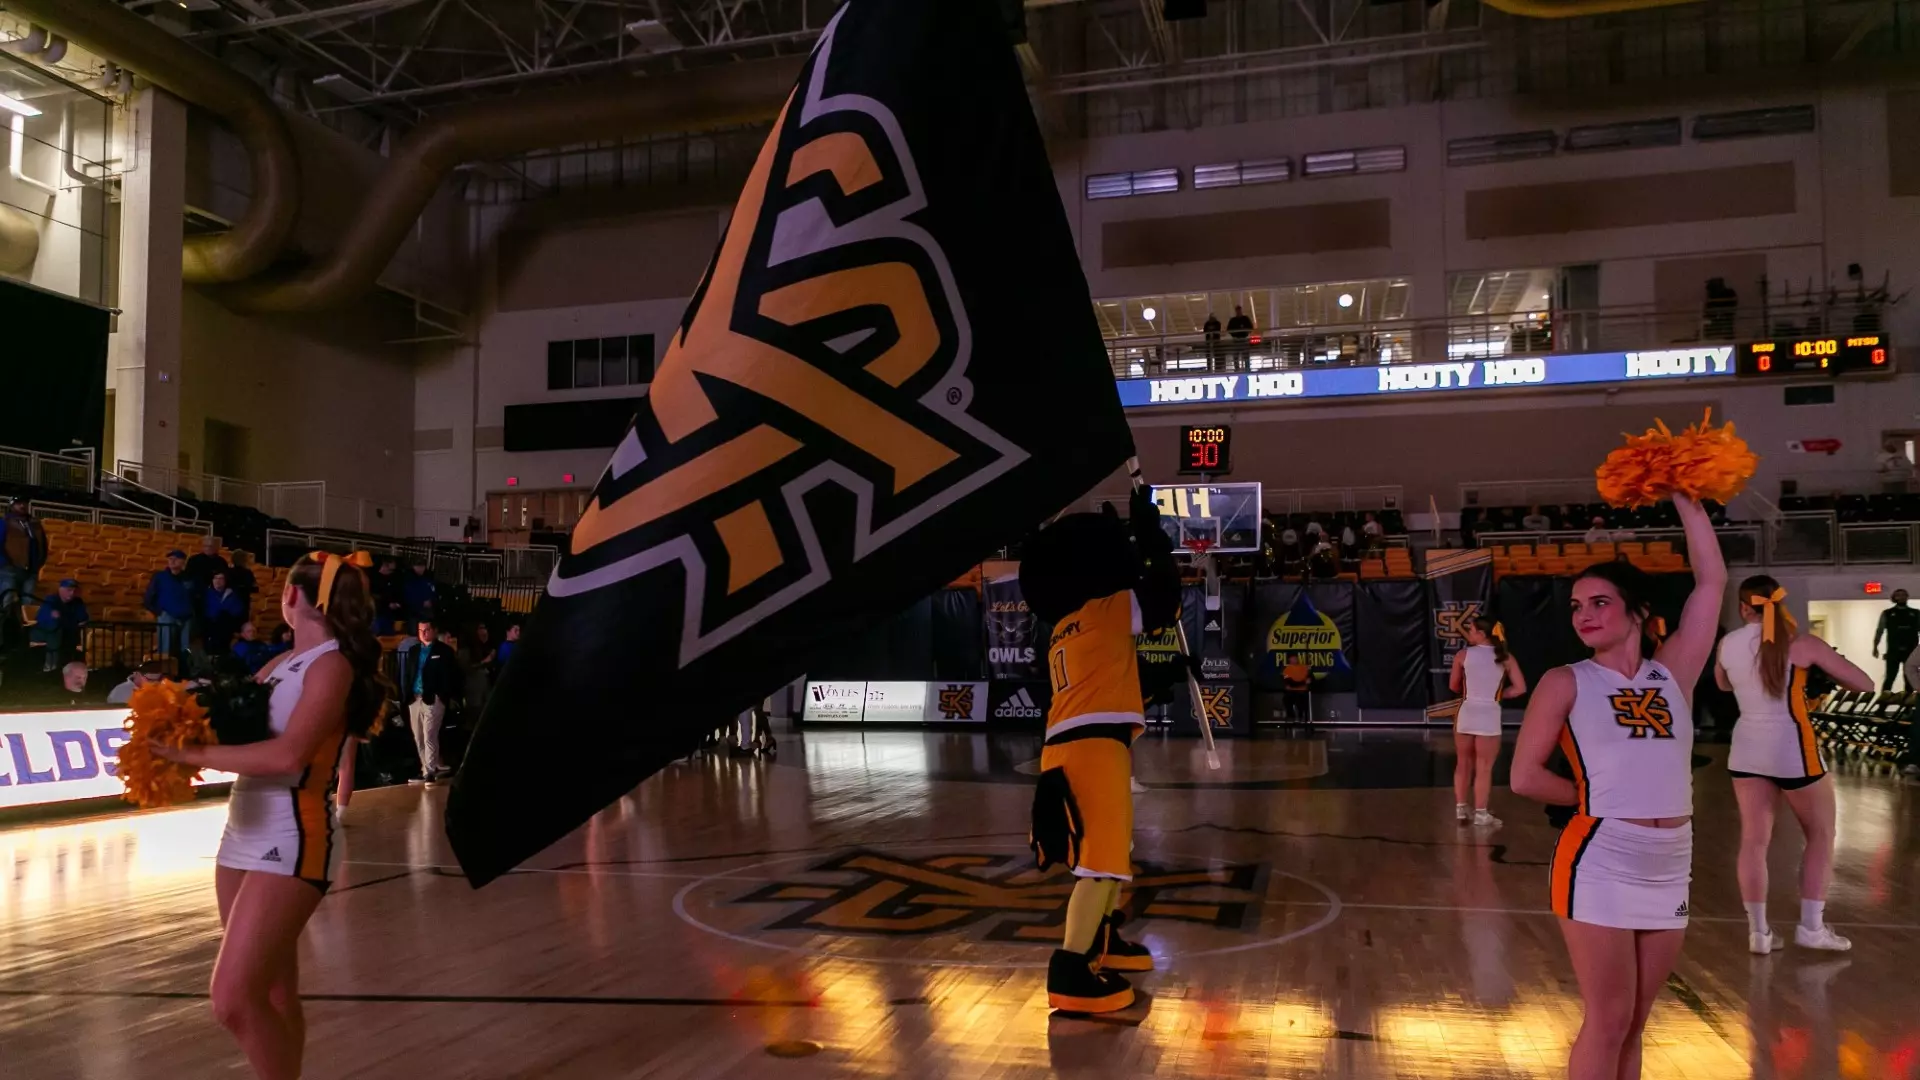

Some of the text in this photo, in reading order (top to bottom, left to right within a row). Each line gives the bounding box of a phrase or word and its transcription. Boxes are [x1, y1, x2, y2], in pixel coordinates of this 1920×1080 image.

[1794, 340, 1837, 355] 10:00
[1625, 346, 1732, 377] HOOTY
[1758, 356, 1771, 371] 0
[1872, 349, 1885, 364] 0
[1378, 358, 1545, 391] HOOTY HOO
[1150, 373, 1303, 402] HOOTY HOO
[1189, 429, 1224, 443] 10:00
[1192, 443, 1218, 467] 30
[1272, 628, 1335, 648] Superior
[988, 647, 1036, 664] OWLS
[1275, 651, 1335, 668] PLMBING
[994, 706, 1042, 718] adidas
